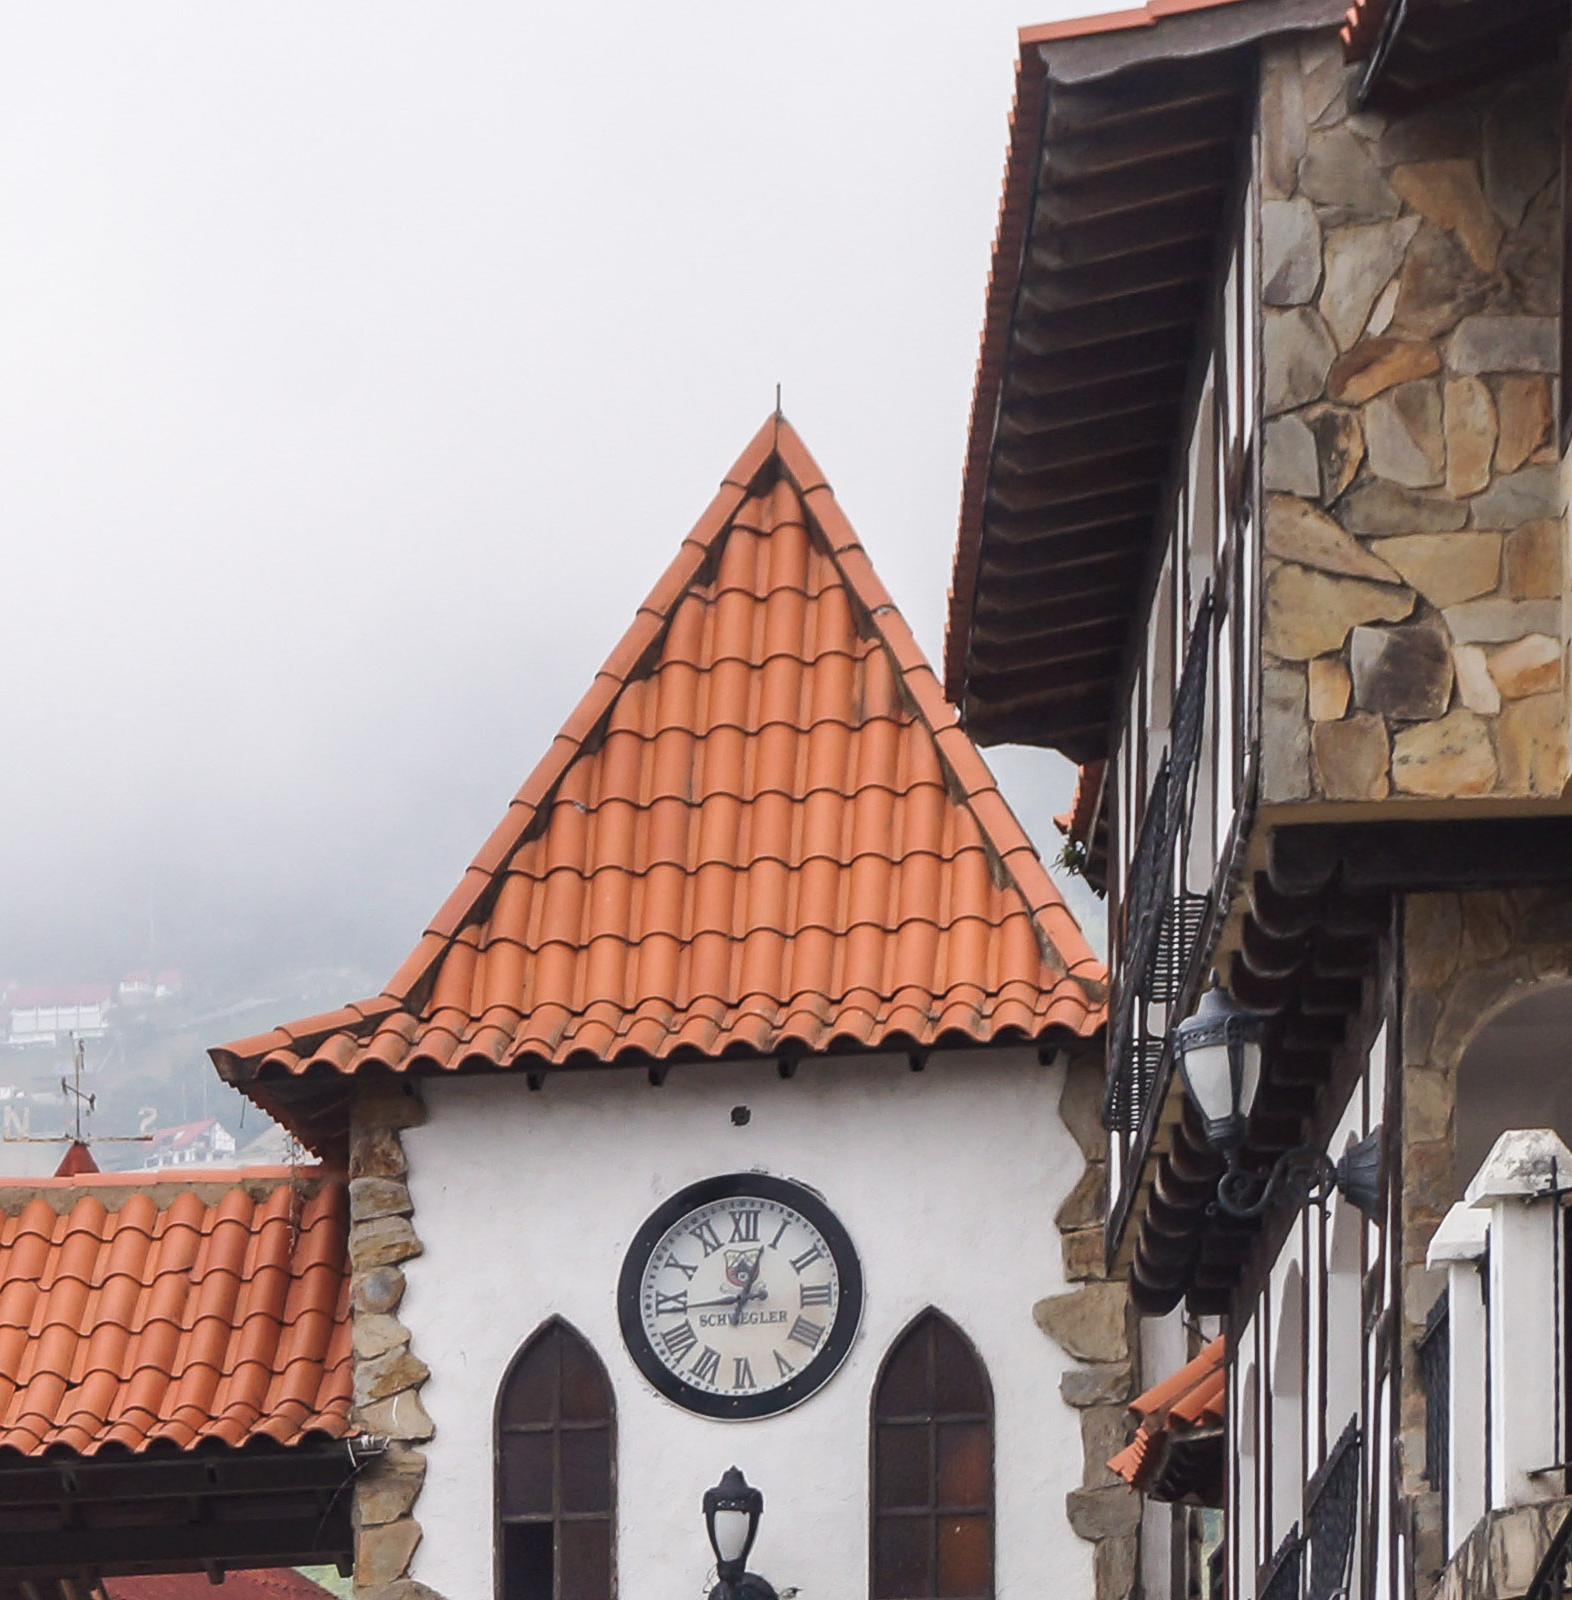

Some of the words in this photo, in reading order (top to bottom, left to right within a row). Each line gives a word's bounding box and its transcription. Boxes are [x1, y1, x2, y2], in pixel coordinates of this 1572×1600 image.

[689, 1219, 725, 1258] XI
[728, 1210, 762, 1243] XII
[768, 1218, 792, 1250] I
[665, 1251, 699, 1281] X
[789, 1244, 824, 1275] II
[655, 1289, 688, 1317] IX
[799, 1282, 833, 1309] III
[660, 1319, 699, 1364] VIII
[688, 1344, 722, 1386] VII
